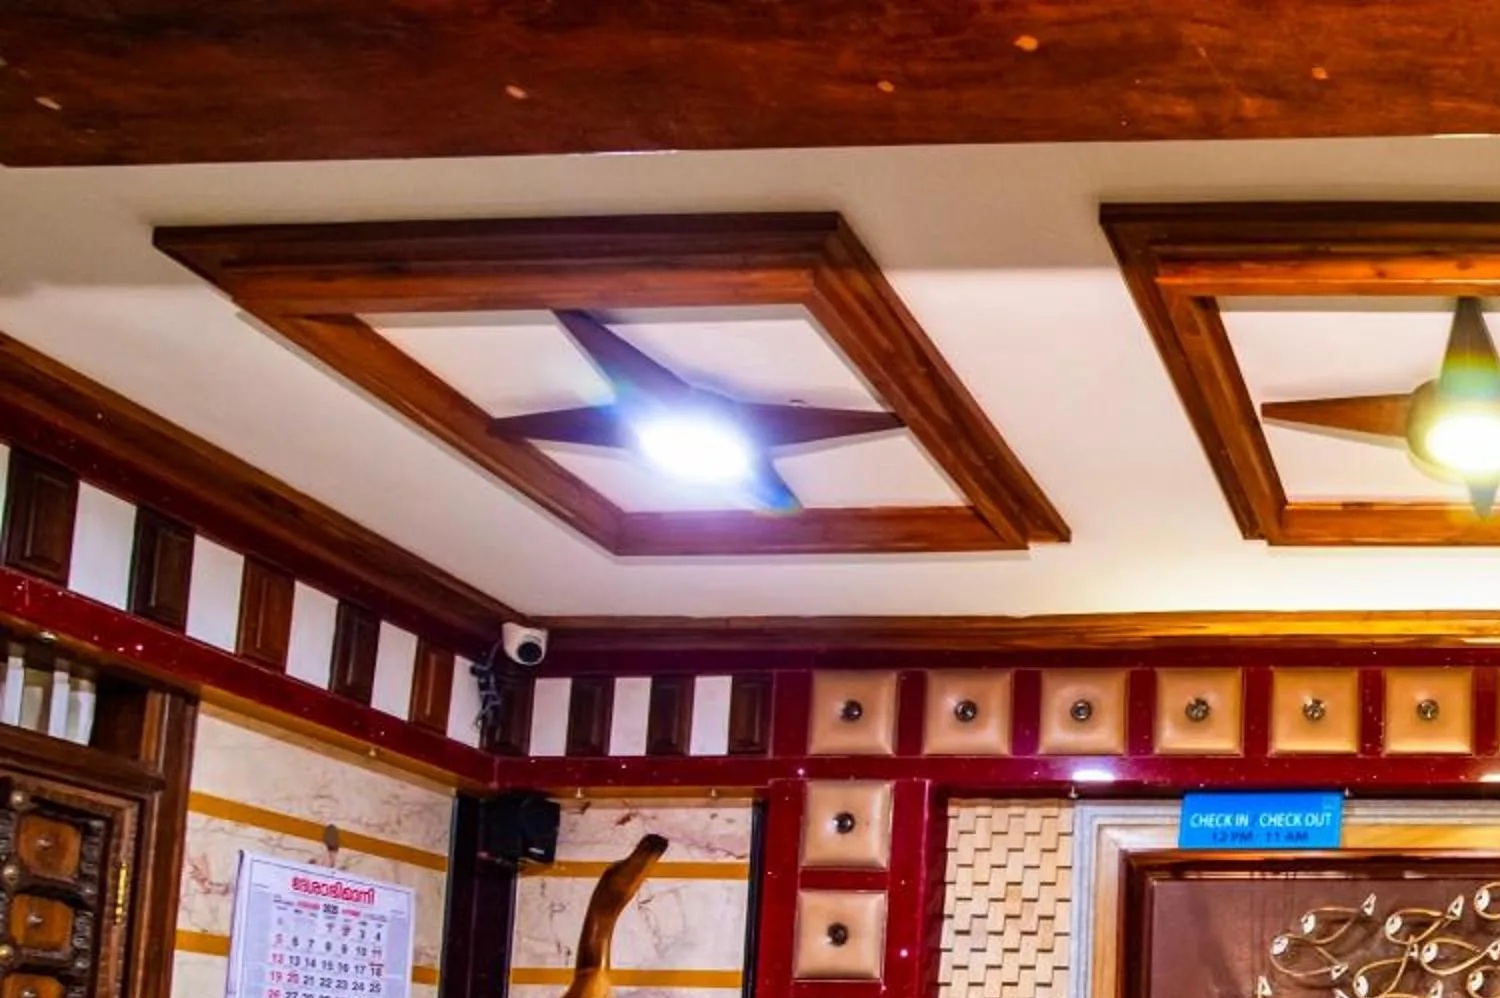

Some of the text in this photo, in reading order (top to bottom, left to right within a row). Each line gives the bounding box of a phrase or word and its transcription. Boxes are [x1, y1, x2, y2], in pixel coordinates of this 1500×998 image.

[1190, 813, 1248, 828] CHECK IN
[1259, 812, 1332, 827] CHECK OUT
[1266, 832, 1280, 842] 11
[308, 939, 315, 948] 7
[357, 946, 367, 956] 10
[272, 954, 382, 977] 12 13 14 15 16 17 18
[271, 972, 381, 993] 19 20 21 22 23 24 25
[269, 989, 281, 998] 26
